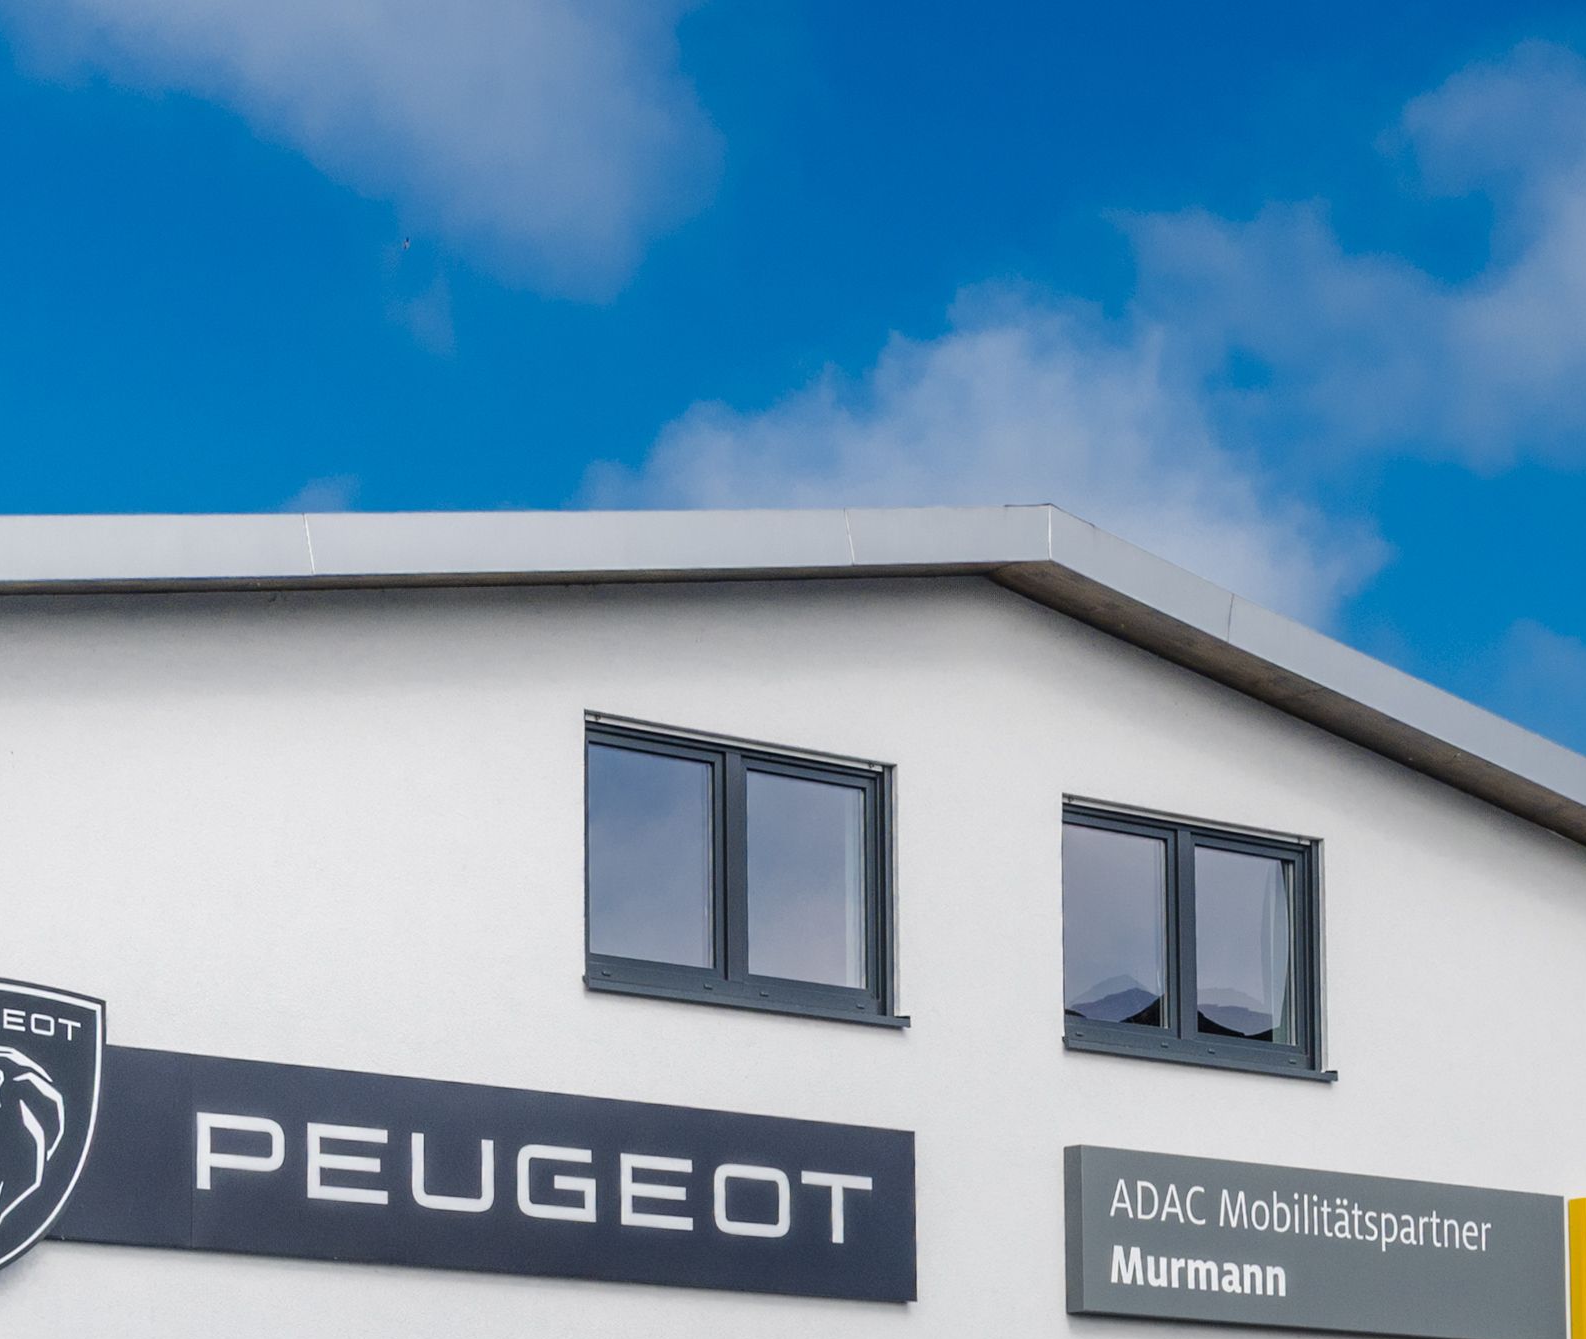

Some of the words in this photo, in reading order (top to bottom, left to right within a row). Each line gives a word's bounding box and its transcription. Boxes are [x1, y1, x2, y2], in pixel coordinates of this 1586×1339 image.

[196, 1112, 874, 1244] PEUGEOT
[1110, 1178, 1206, 1226] ADAC
[1219, 1189, 1491, 1253] Mobilitätspartner
[1110, 1245, 1287, 1297] Murmann
